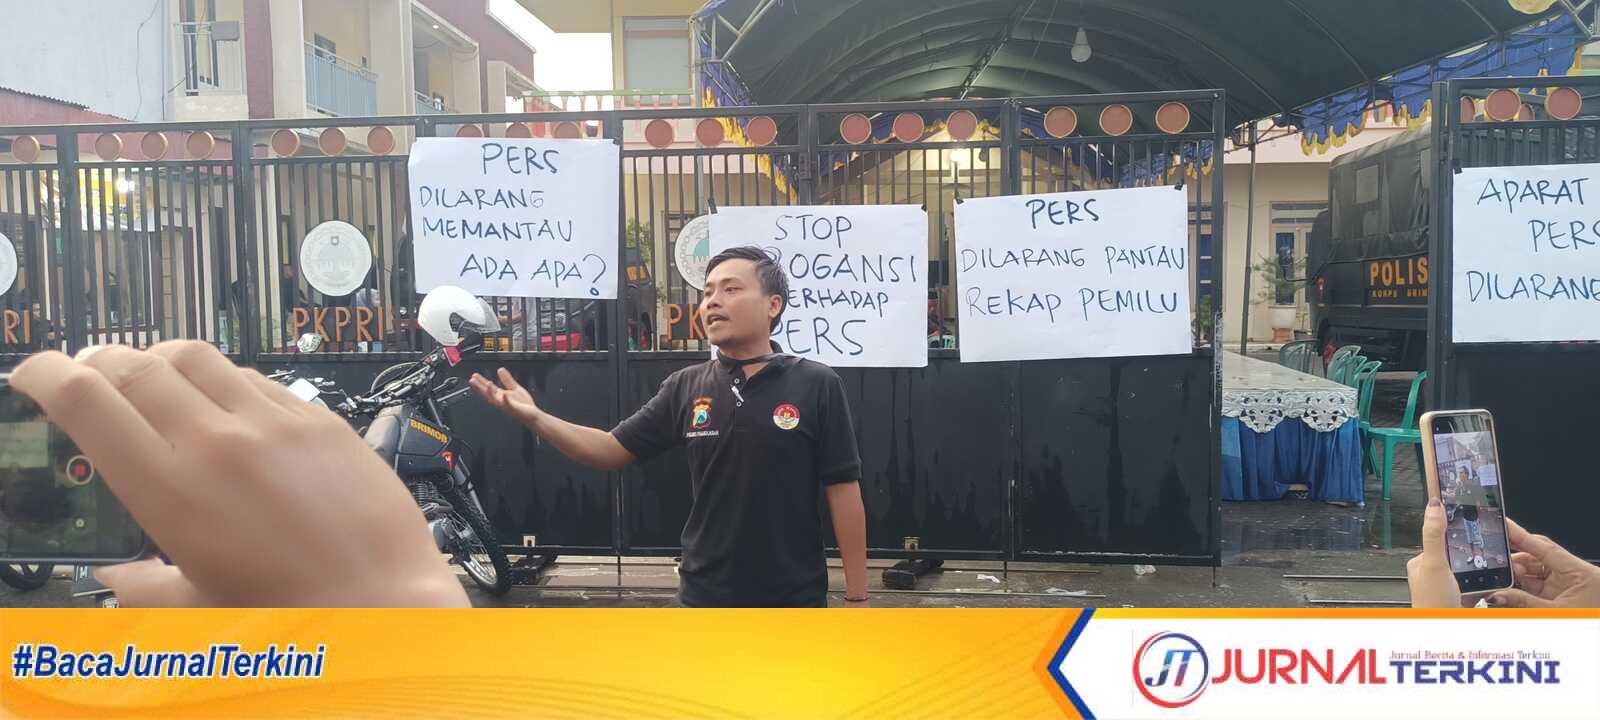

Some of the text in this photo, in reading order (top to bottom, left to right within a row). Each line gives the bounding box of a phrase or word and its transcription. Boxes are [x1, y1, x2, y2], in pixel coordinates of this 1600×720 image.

[482, 143, 560, 175] PERS
[419, 185, 545, 211] DILARANG
[1477, 177, 1590, 214] APARAT
[423, 216, 573, 242] MEMANTAU
[1026, 198, 1100, 230] PERS
[774, 213, 852, 248] STOP
[459, 253, 607, 297] ADA APA?
[789, 251, 917, 283] OGANSI
[961, 245, 1185, 274] DILARANG PANTAU
[786, 287, 889, 317] ERHADAP
[966, 286, 1178, 324] REKAP PEMILU
[293, 306, 385, 343] PKPRI
